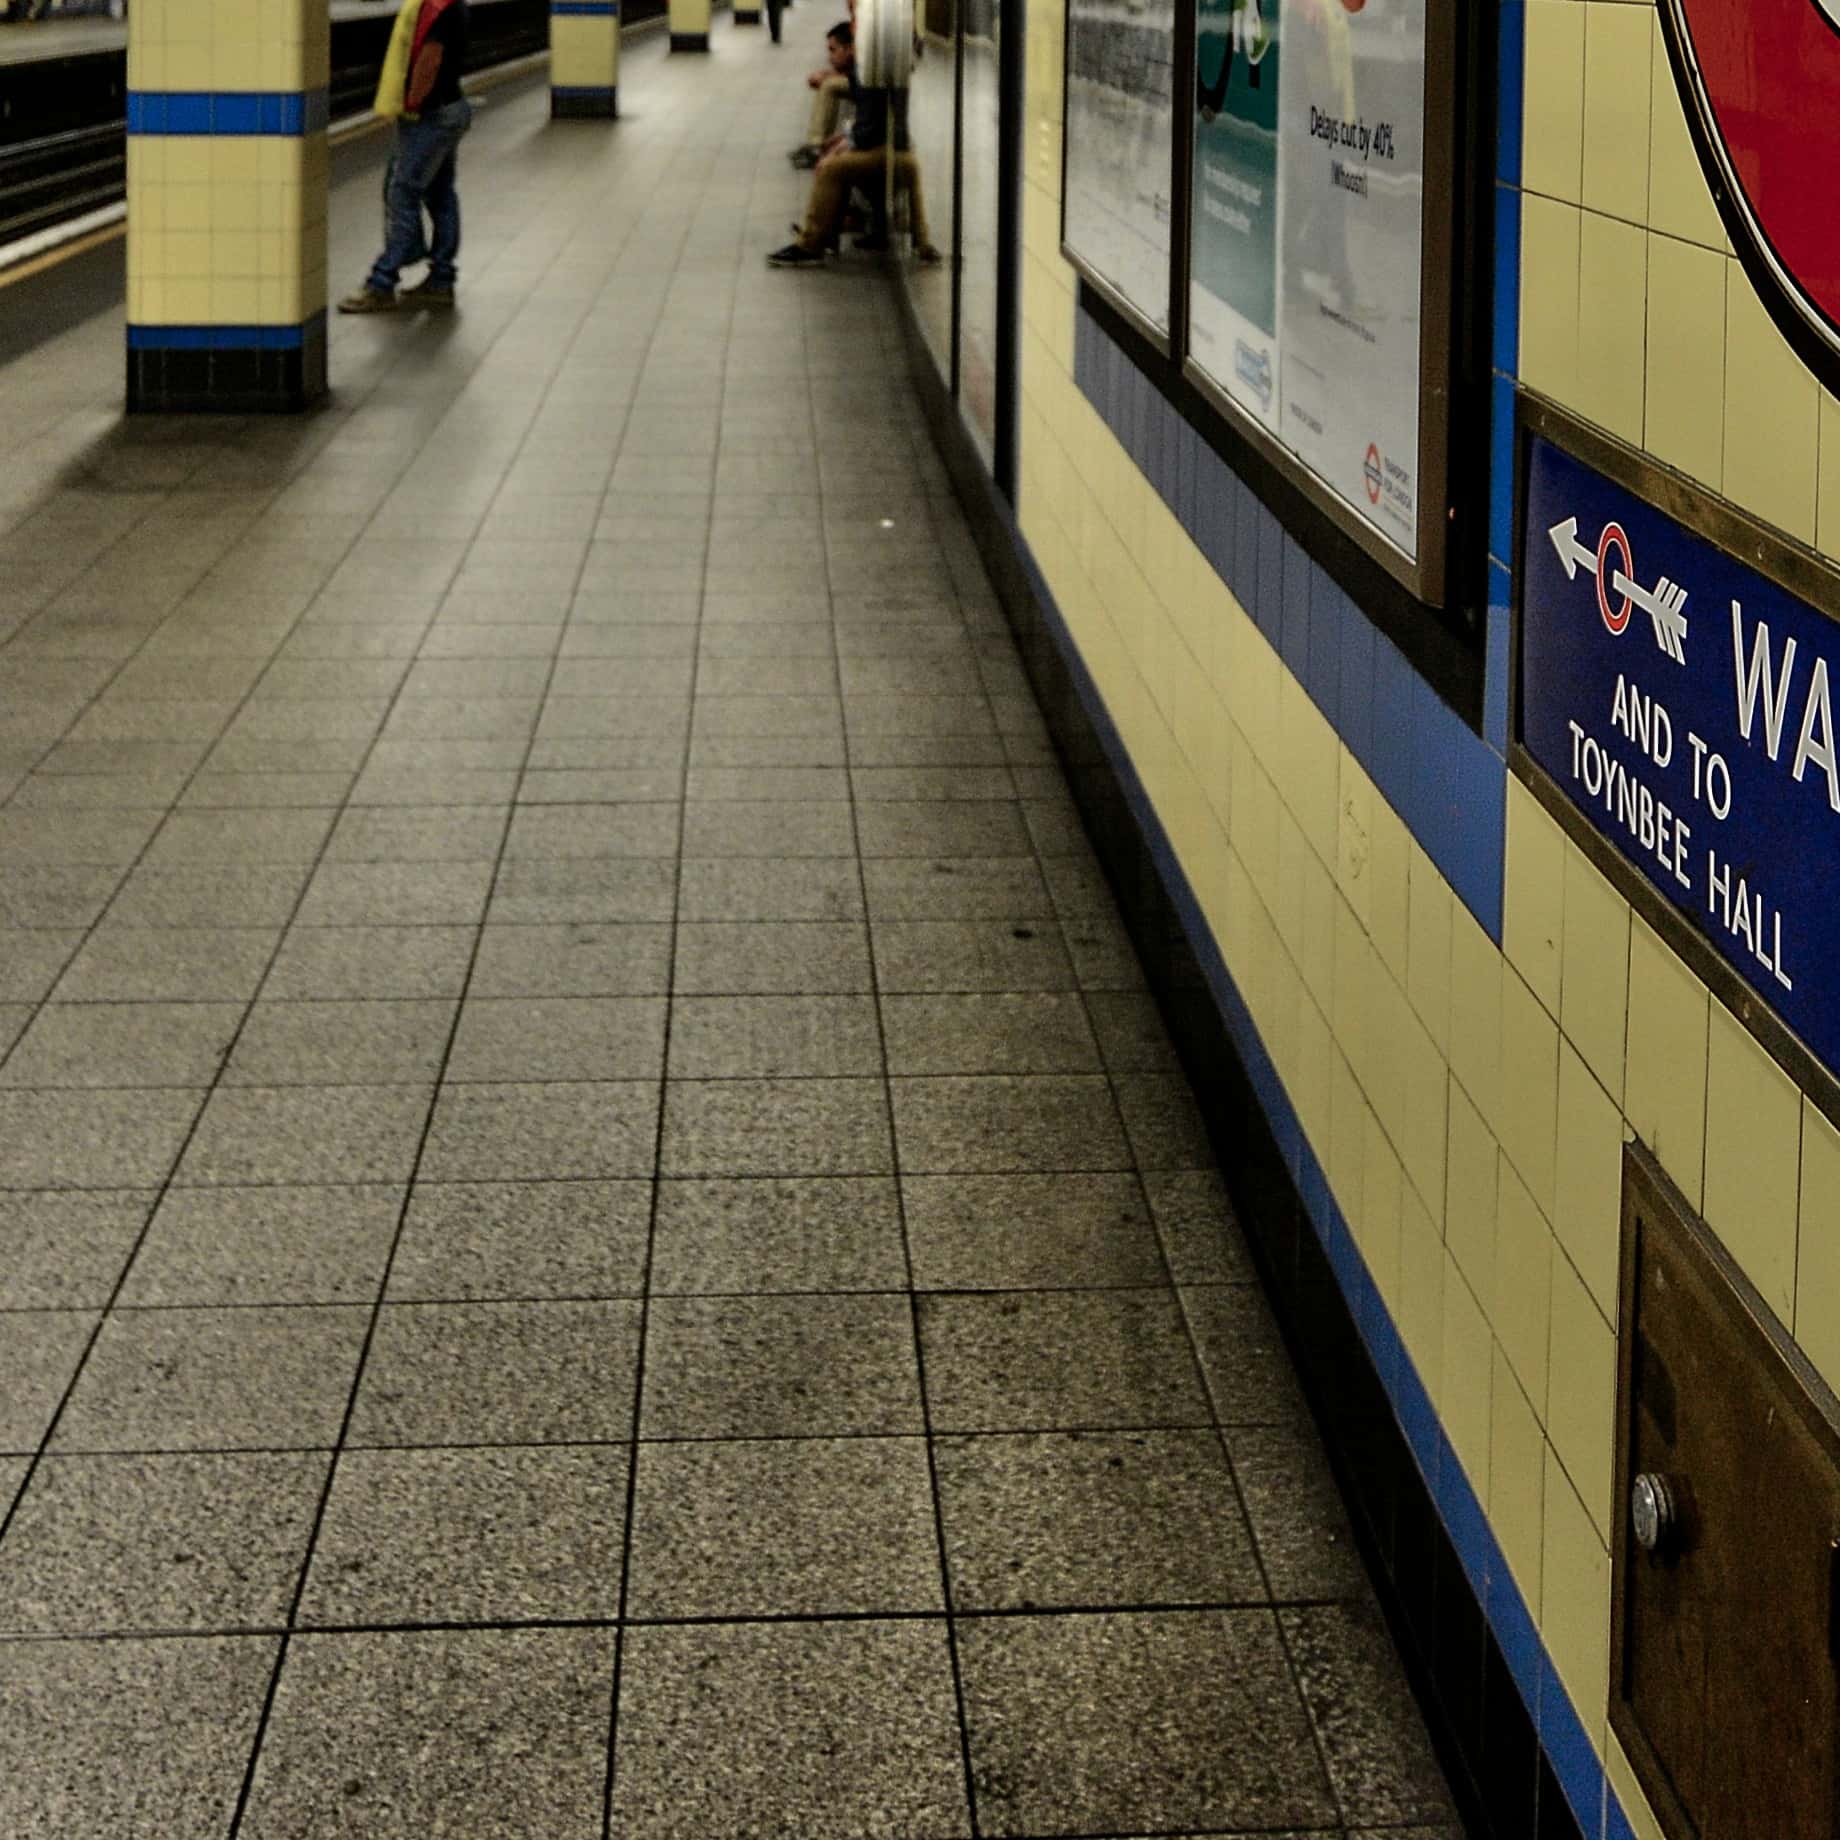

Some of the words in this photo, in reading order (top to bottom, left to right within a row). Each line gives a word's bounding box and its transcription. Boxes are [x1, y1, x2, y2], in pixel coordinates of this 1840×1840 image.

[1310, 105, 1339, 150] Delays
[1341, 121, 1357, 150] cut
[1359, 117, 1372, 161] by
[1373, 122, 1395, 160] 40%
[1610, 673, 1673, 768] AND
[1687, 731, 1732, 821] TO
[1568, 719, 1691, 890] TOYNBEE
[1708, 849, 1793, 992] HALL
